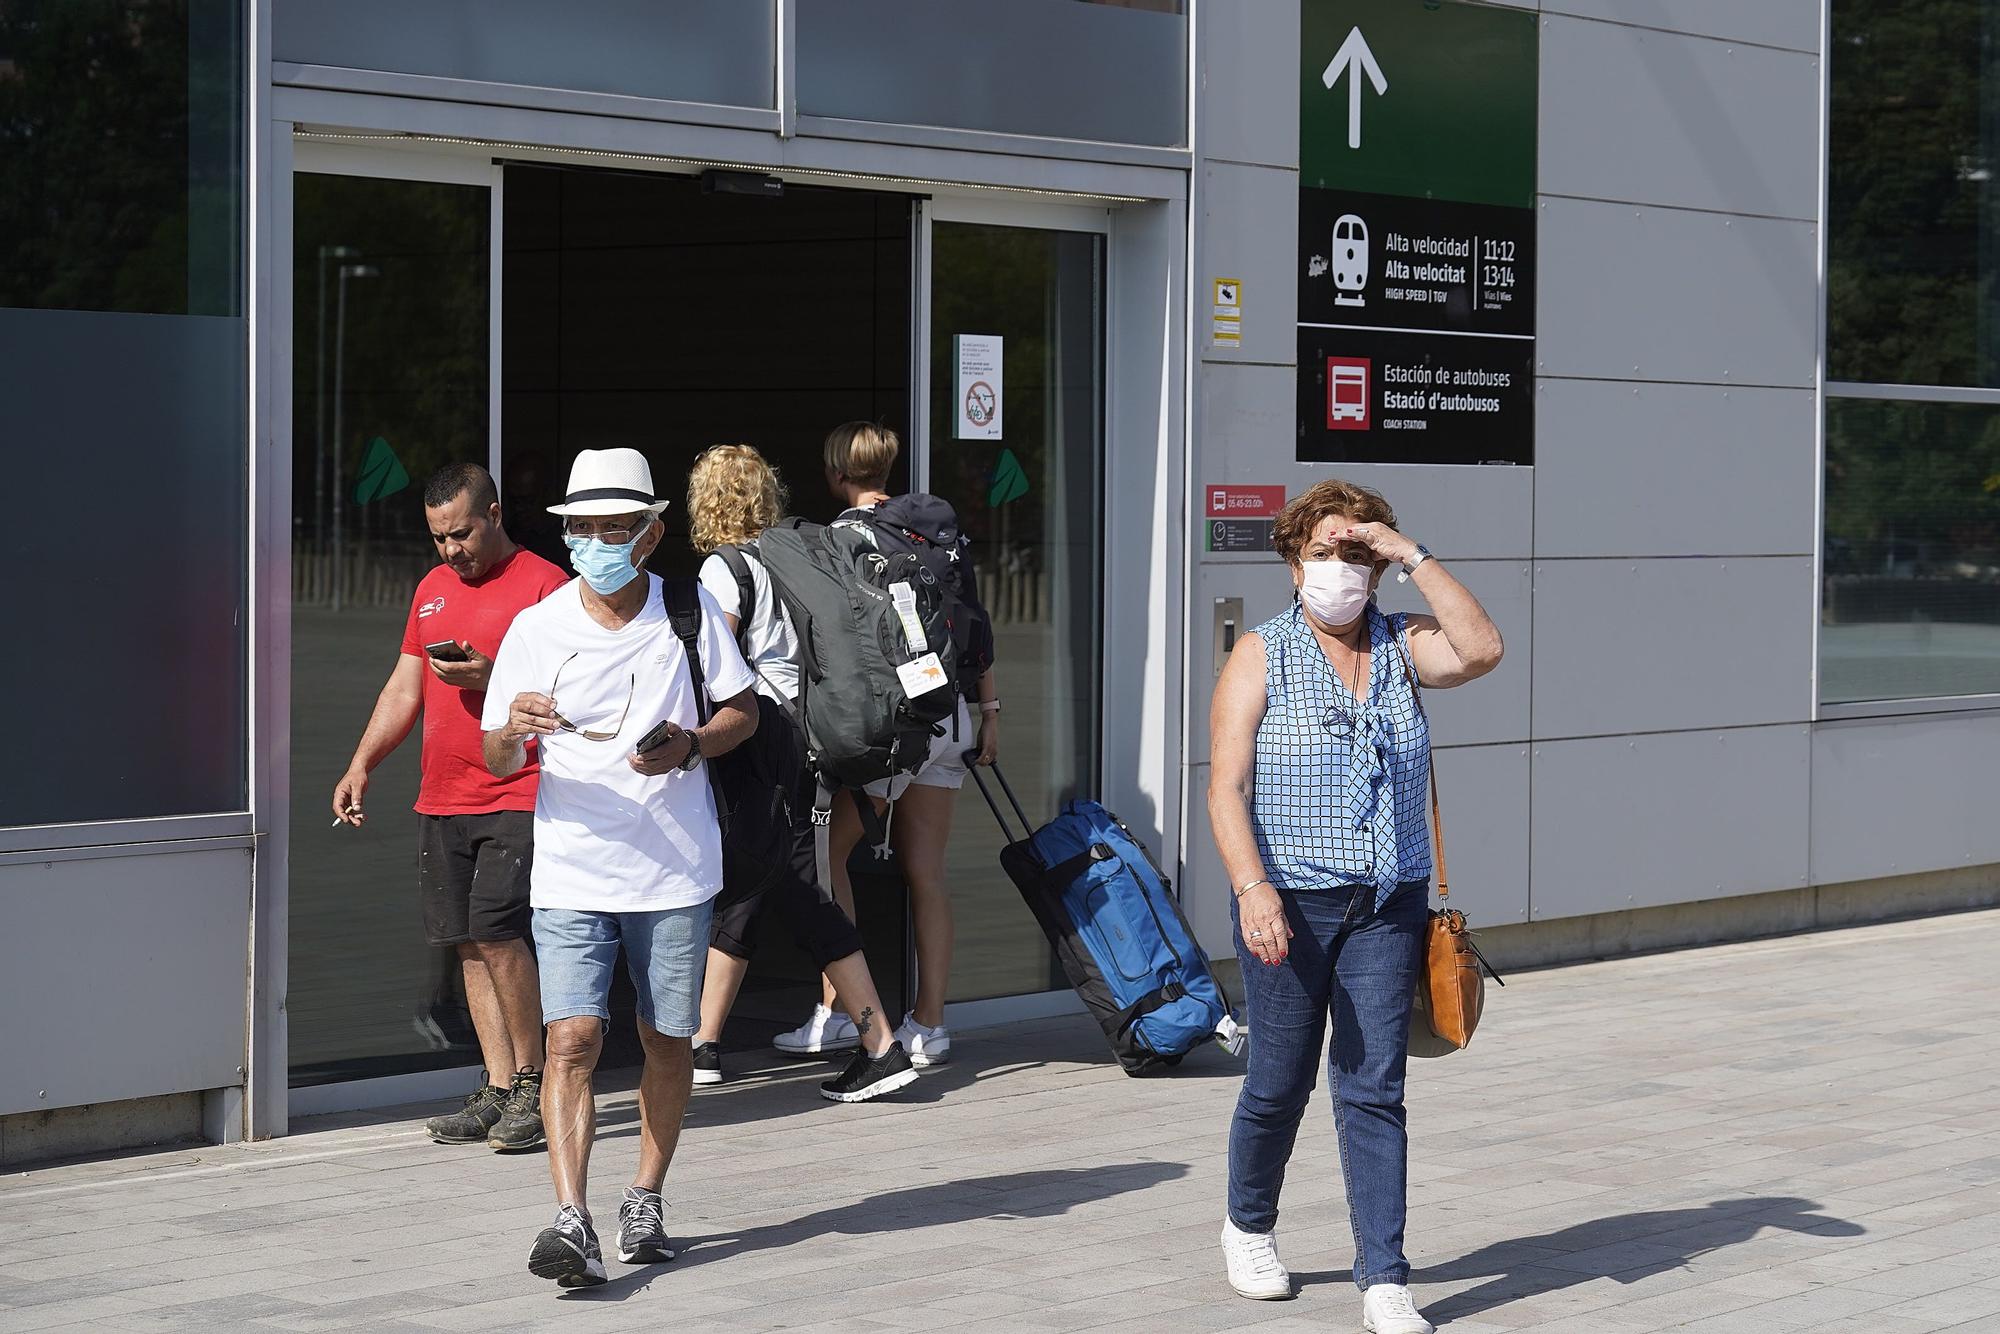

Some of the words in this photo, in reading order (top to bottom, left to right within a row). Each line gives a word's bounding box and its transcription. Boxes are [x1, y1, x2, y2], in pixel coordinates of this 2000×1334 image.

[1385, 232, 1409, 252] Alta
[1412, 235, 1469, 257] velocidad
[1385, 260, 1410, 279] Alta
[1413, 262, 1466, 284] velocitat
[1385, 287, 1404, 300] HIGH
[1405, 288, 1428, 301] SPEED
[1433, 290, 1448, 303] TGV
[1384, 364, 1432, 383] Estación
[1435, 366, 1450, 384] de
[1453, 368, 1511, 387] autobuses
[1384, 390, 1426, 410] Estació
[1428, 392, 1500, 412] d'autobusos
[1383, 418, 1403, 430] COACH
[1403, 419, 1427, 430] STATION
